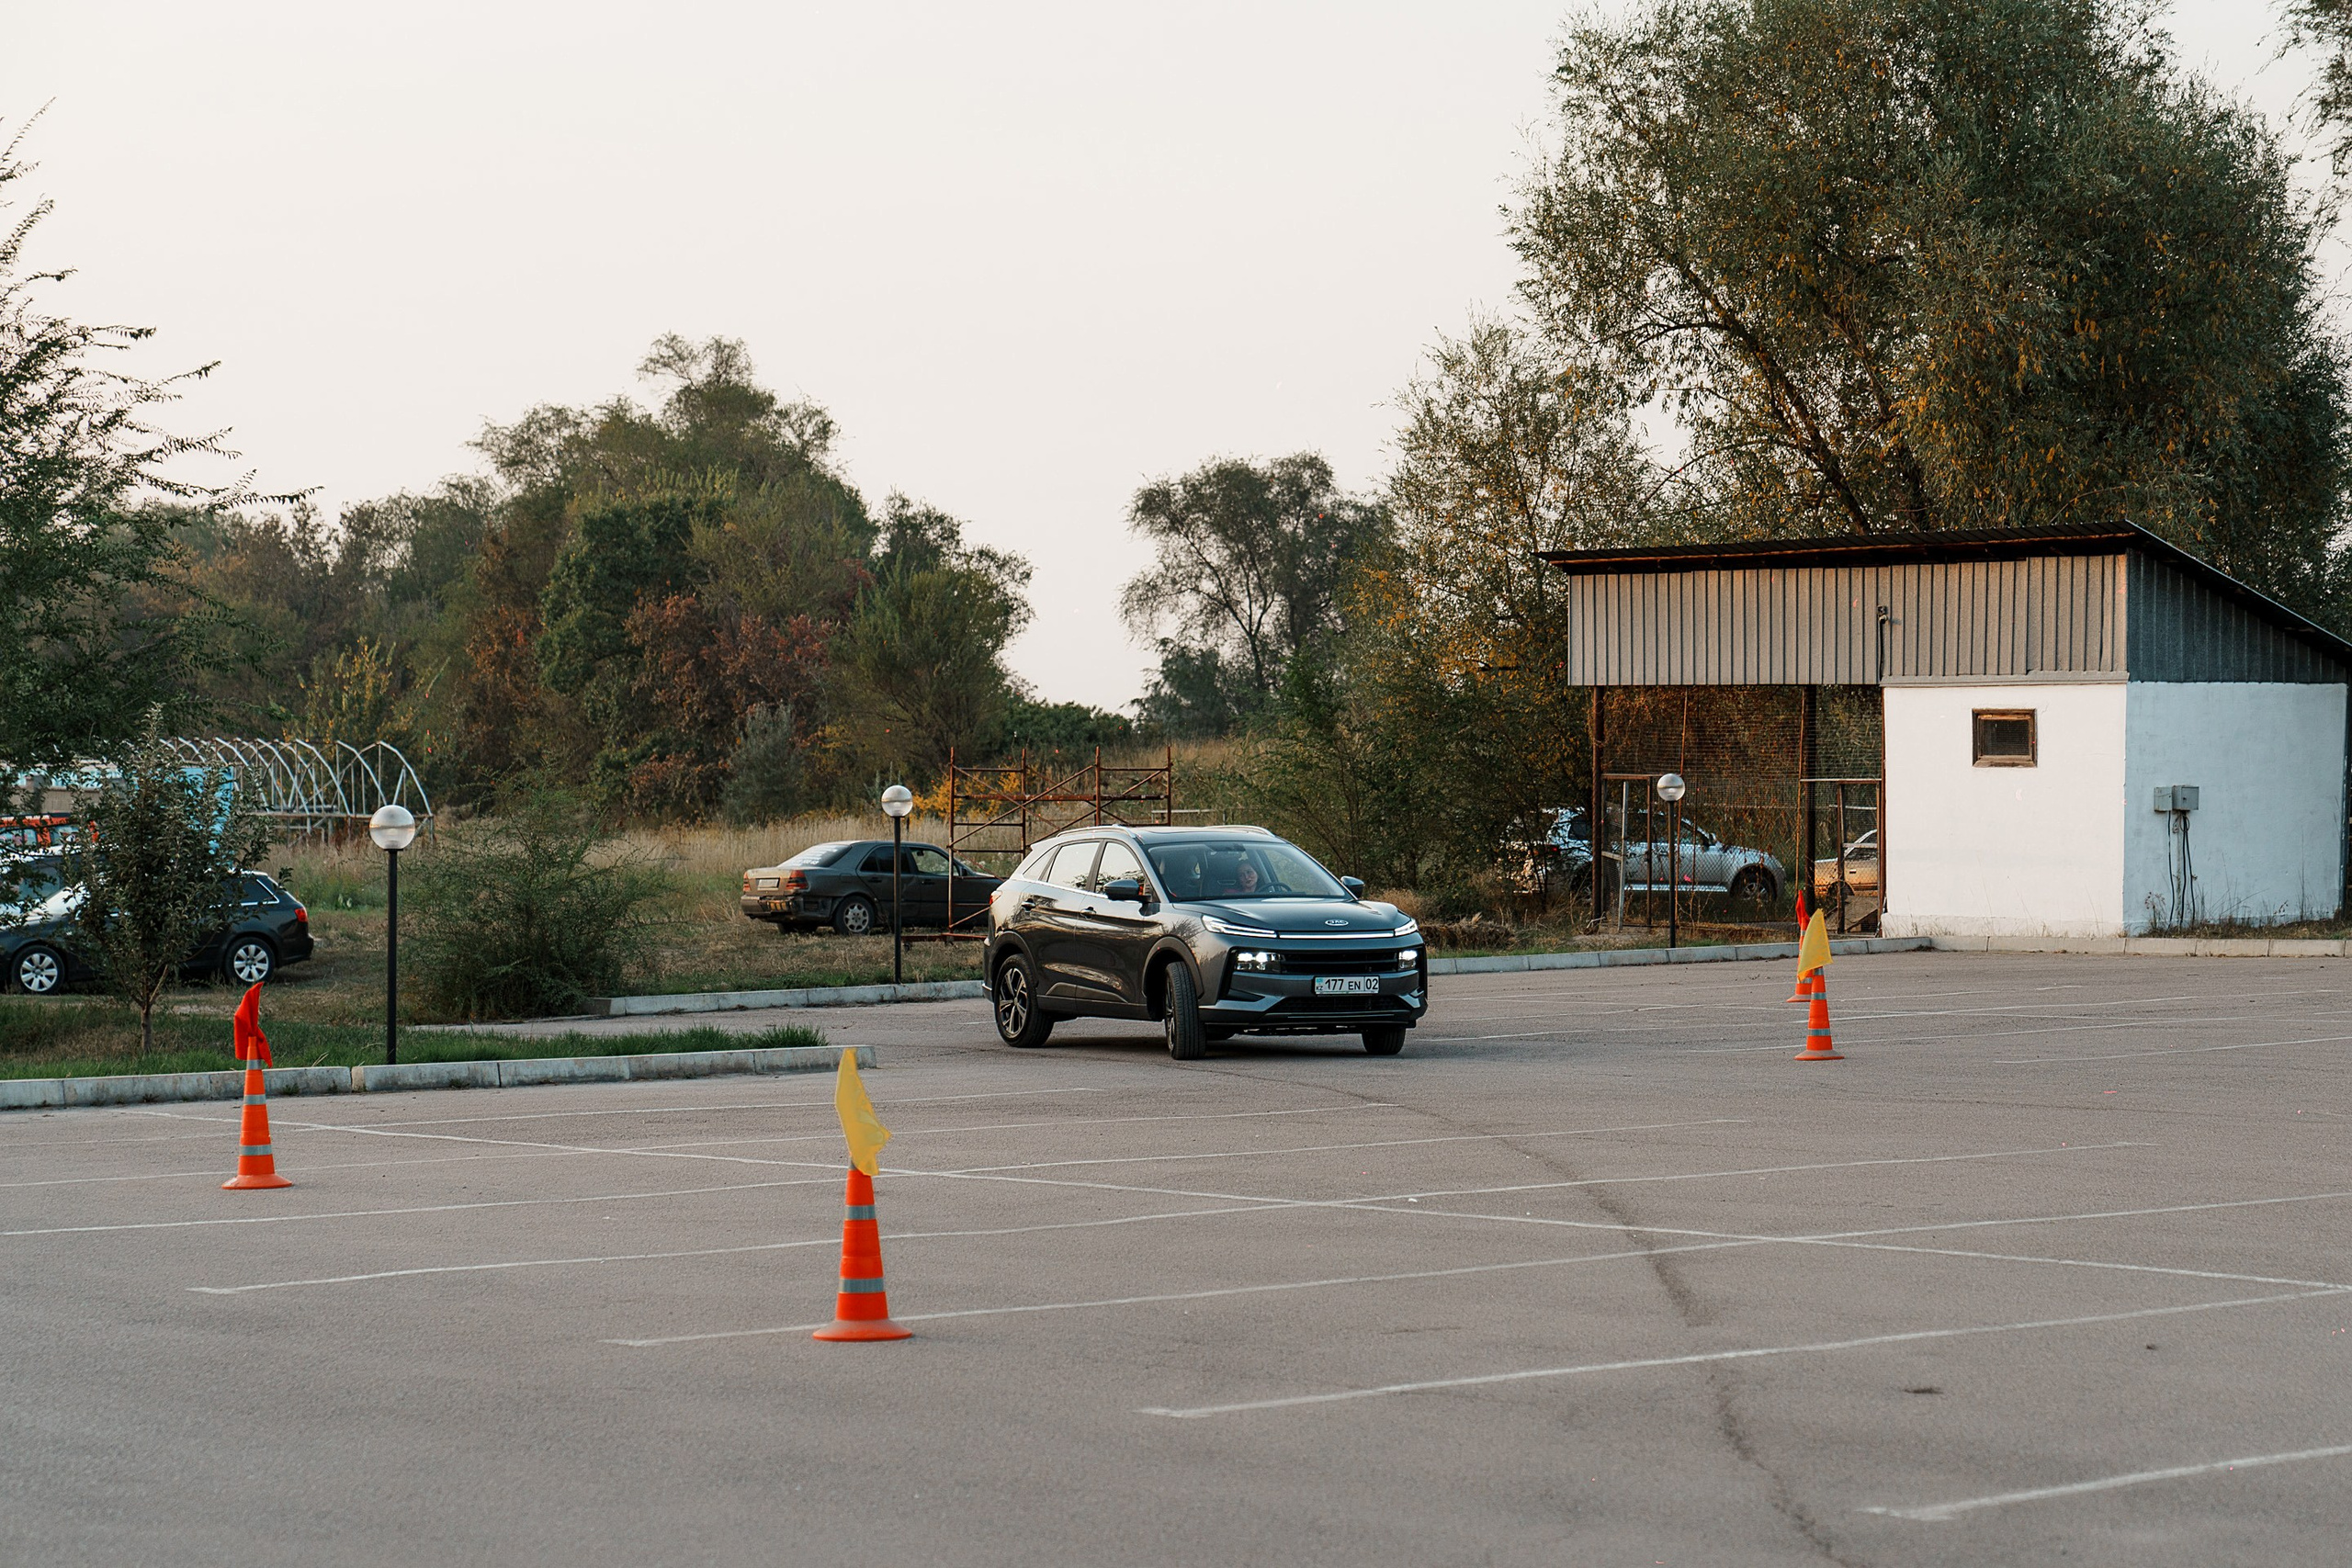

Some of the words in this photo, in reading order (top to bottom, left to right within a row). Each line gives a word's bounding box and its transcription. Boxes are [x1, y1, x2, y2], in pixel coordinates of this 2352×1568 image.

[1325, 978, 1344, 990] 177
[1348, 981, 1361, 990] EN
[1365, 978, 1378, 990] 02
